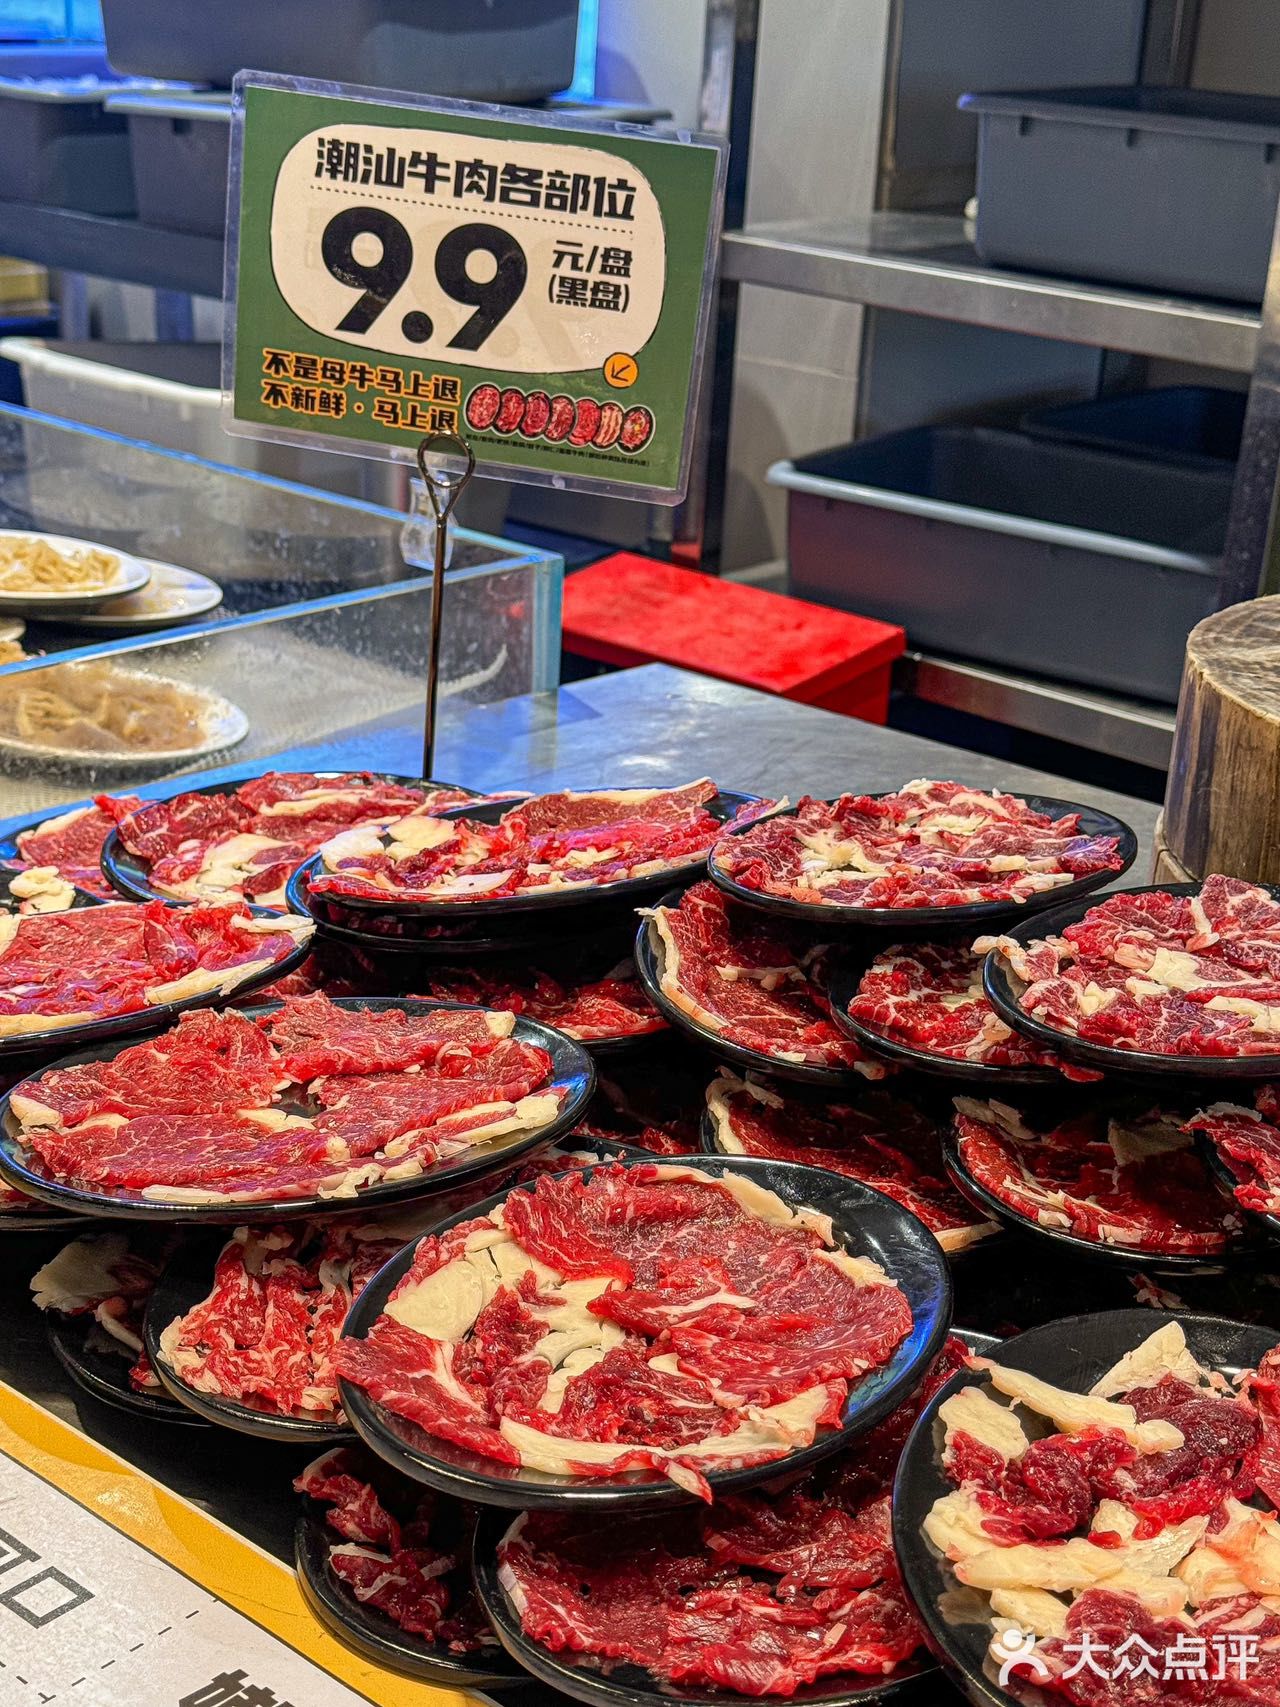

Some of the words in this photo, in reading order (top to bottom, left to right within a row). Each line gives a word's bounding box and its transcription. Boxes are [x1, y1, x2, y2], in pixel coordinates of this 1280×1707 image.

[314, 137, 637, 221] 潮汕牛肉各部位
[321, 206, 528, 352] 9.9
[552, 239, 633, 278] 元/盘
[548, 274, 630, 313] (黑盘)
[263, 348, 461, 406] 不是母牛马上退
